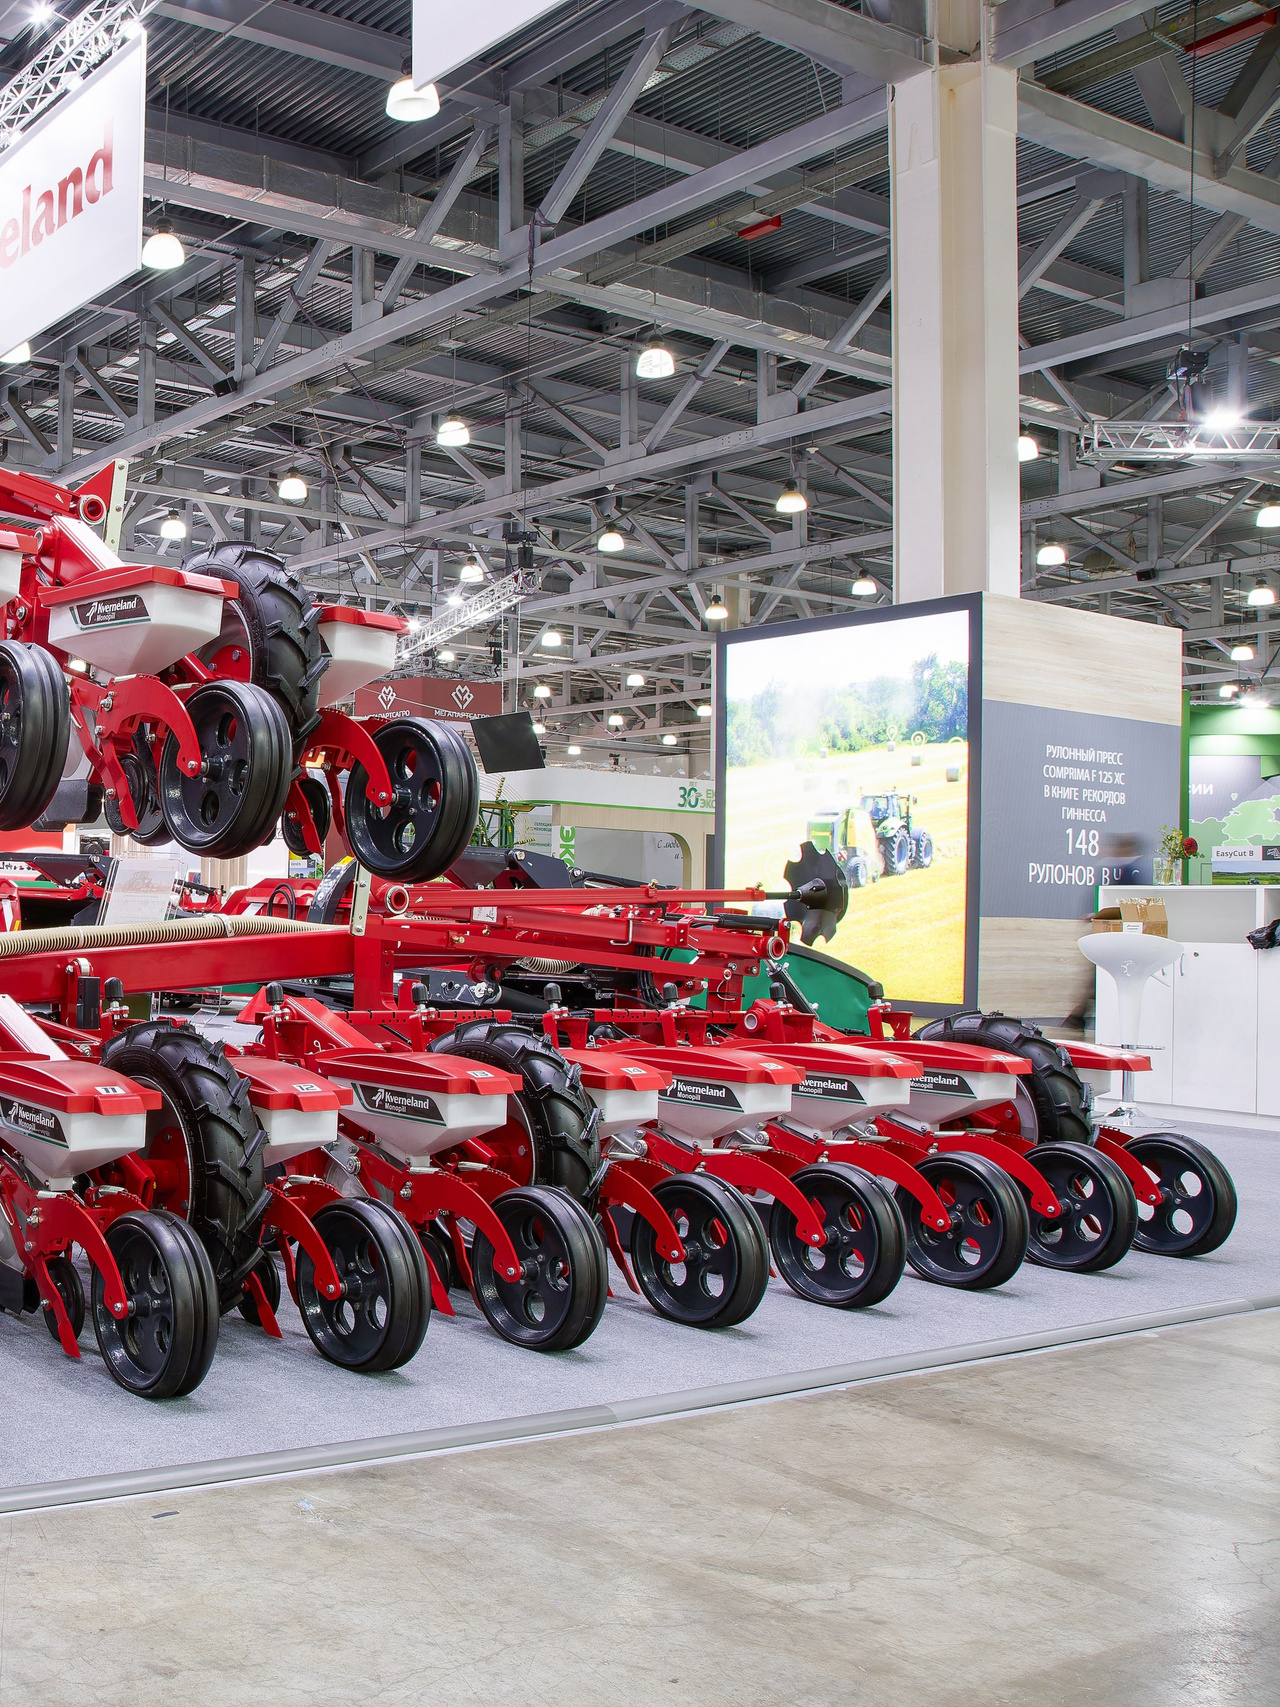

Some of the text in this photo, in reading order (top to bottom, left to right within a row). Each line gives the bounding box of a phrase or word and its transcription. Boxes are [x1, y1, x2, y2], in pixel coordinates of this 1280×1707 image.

[97, 598, 137, 615] Kverneland
[1046, 745, 1123, 766] РУЛОННЫЙ ПРЕСС
[1043, 764, 1090, 782] COMPRIMA
[1091, 769, 1097, 782] F
[1098, 771, 1113, 784] 125
[678, 786, 699, 808] 30
[1044, 784, 1126, 806] В КНИГЕ РЕКОРДОВ
[1188, 783, 1214, 796] ИИ
[1061, 806, 1107, 823] ГИННЕССА
[1065, 827, 1100, 857] 148
[1216, 850, 1246, 859] EasyCut
[1028, 862, 1096, 886] РУЛОНОВ
[296, 1083, 316, 1091] 12
[677, 1081, 726, 1098] Kverneland
[799, 1085, 823, 1095] Monopill
[384, 1091, 430, 1110] Kverneland
[677, 1091, 701, 1101] Monopill
[384, 1103, 407, 1113] Monopill
[18, 1106, 55, 1129] Kverneland
[18, 1118, 36, 1131] Monopill
